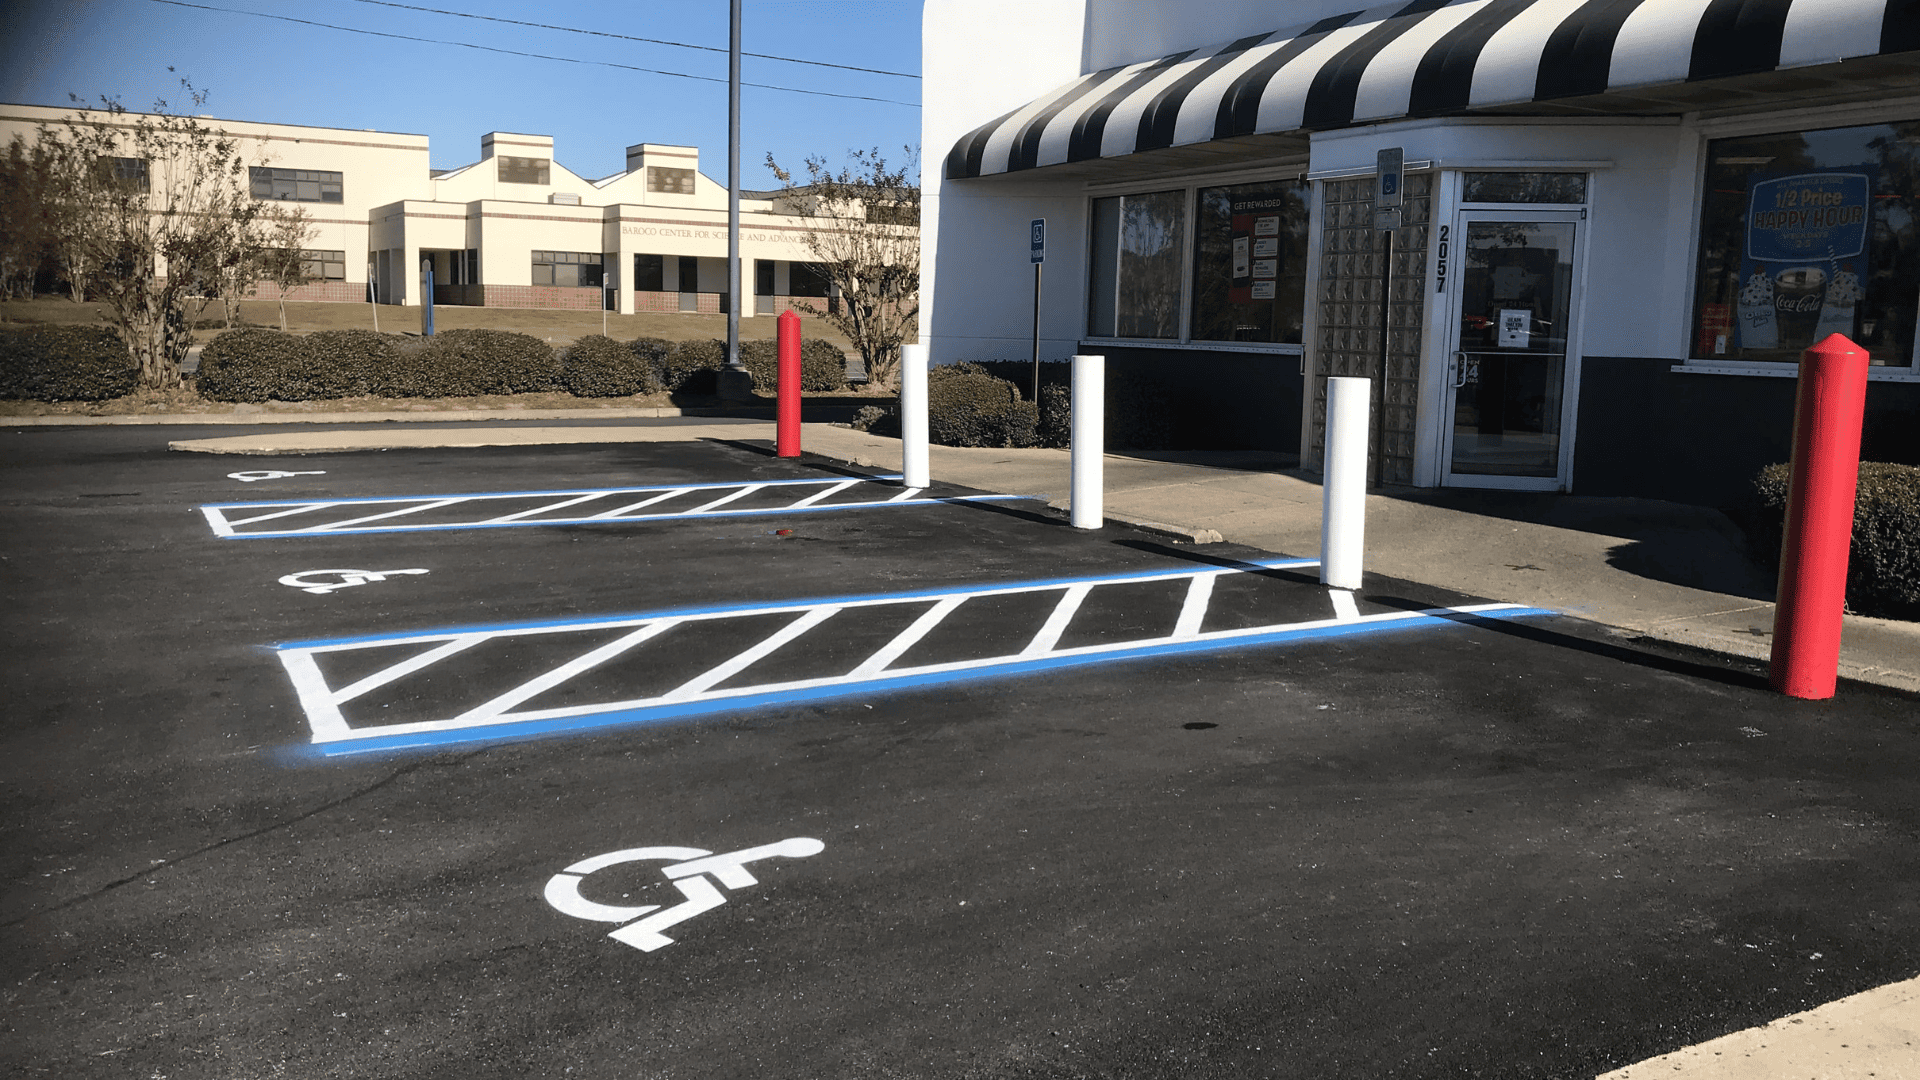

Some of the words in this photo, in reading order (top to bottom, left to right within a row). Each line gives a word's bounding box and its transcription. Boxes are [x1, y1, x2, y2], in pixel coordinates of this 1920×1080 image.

[1234, 201, 1247, 210] GET
[1247, 198, 1281, 209] REWARDED
[1775, 190, 1798, 208] 1/2
[1801, 187, 1843, 207] Price
[1754, 209, 1809, 229] HAPPY
[1813, 205, 1864, 229] HOUR
[622, 226, 657, 236] BAROCO
[659, 228, 692, 238] CENTER
[694, 230, 710, 239] FOR
[712, 231, 744, 240] SCIEE
[747, 233, 766, 242] AND
[1437, 225, 1449, 293] 2057
[1776, 294, 1822, 312] Coca-Cola
